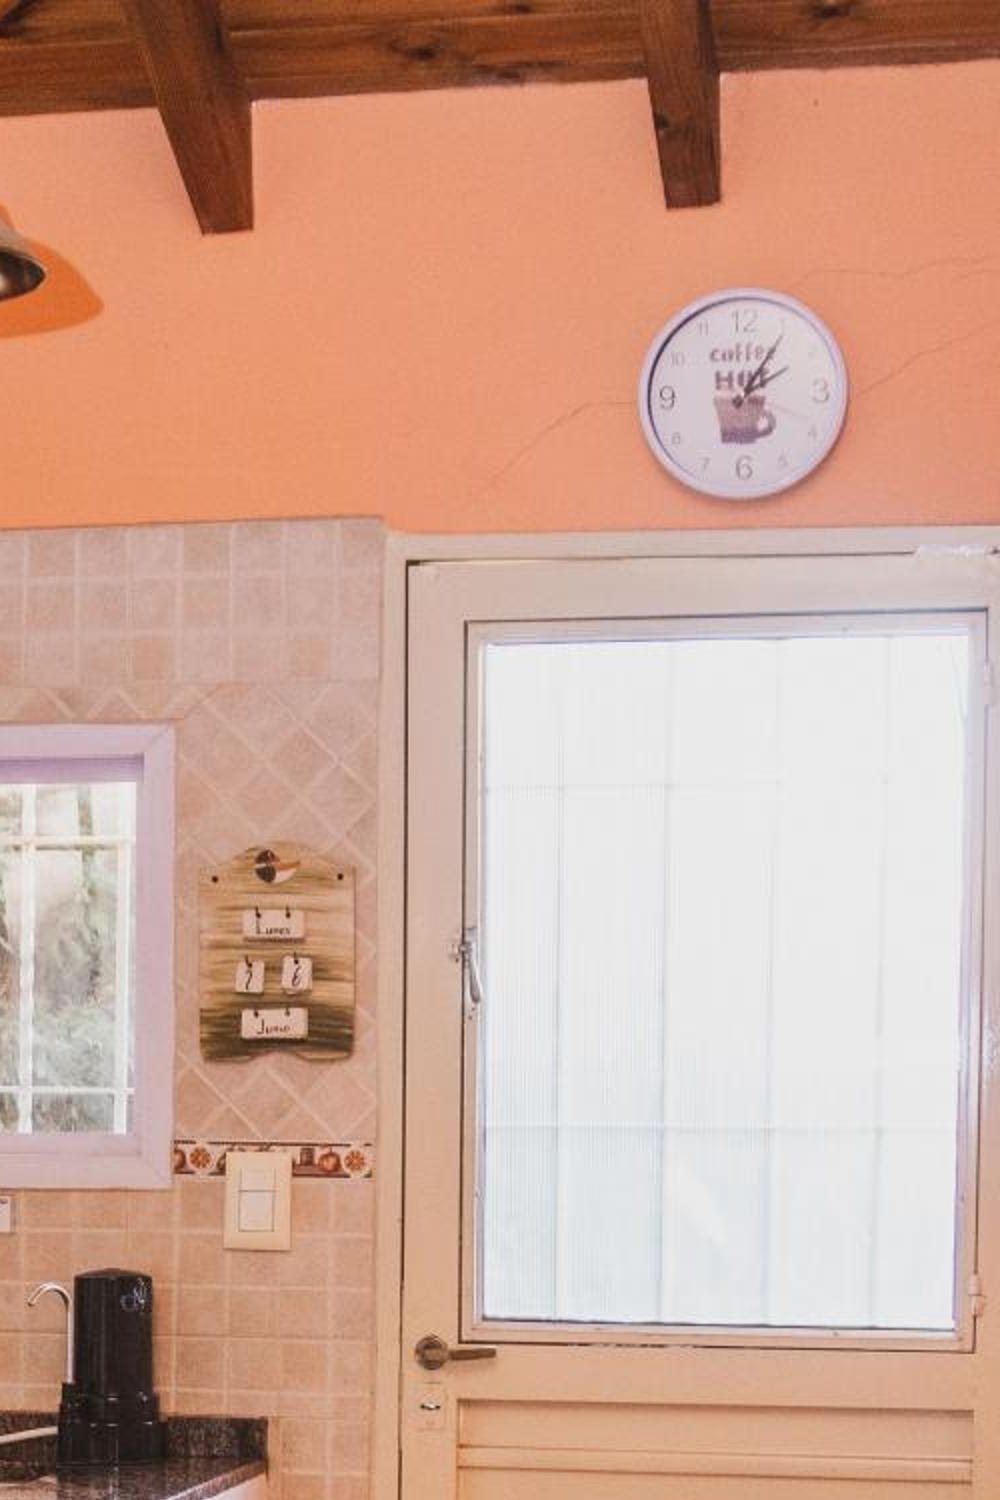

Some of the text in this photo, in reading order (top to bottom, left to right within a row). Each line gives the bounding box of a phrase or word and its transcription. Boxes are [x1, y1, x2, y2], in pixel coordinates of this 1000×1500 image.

[732, 308, 759, 333] 12
[659, 384, 676, 411] 9
[812, 377, 830, 404] 3
[735, 454, 754, 481] 6
